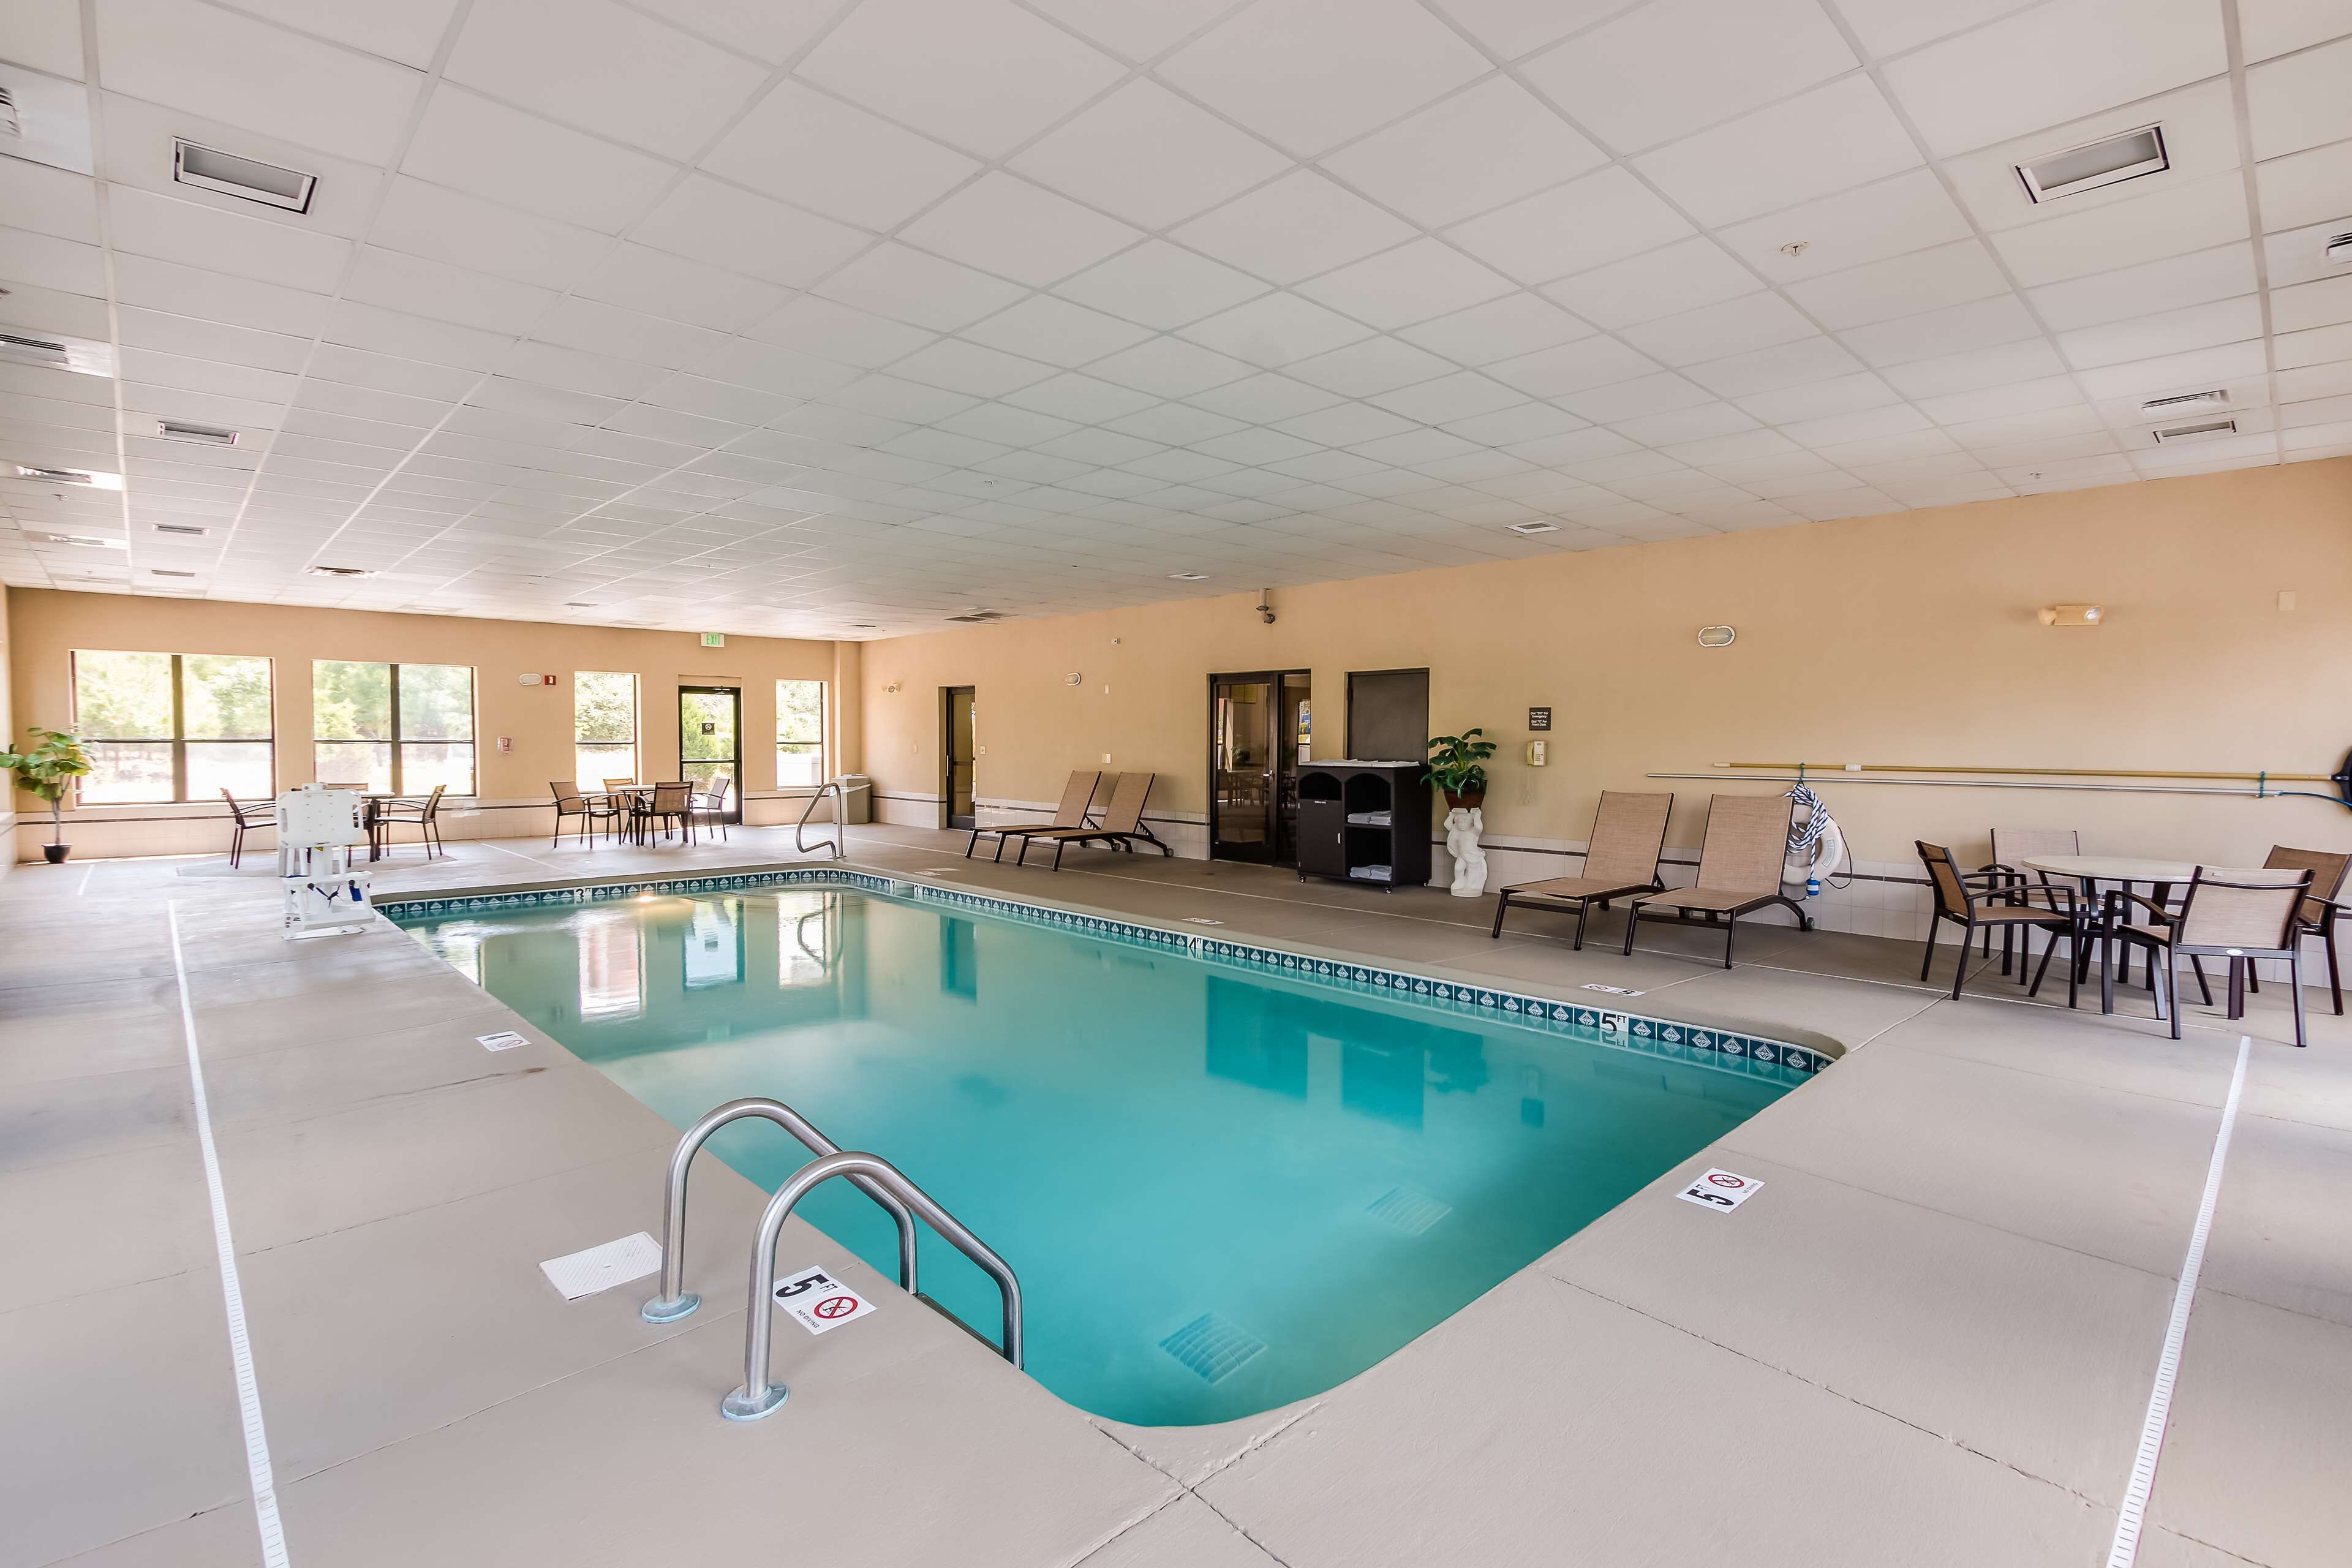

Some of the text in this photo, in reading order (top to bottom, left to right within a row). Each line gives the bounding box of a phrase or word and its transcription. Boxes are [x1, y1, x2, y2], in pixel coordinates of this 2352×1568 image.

[706, 634, 720, 645] EXIT
[1602, 1012, 1617, 1031] 5
[1686, 1188, 1735, 1206] 5
[775, 1273, 838, 1297] 5 FT
[803, 1315, 820, 1329] DIVING
